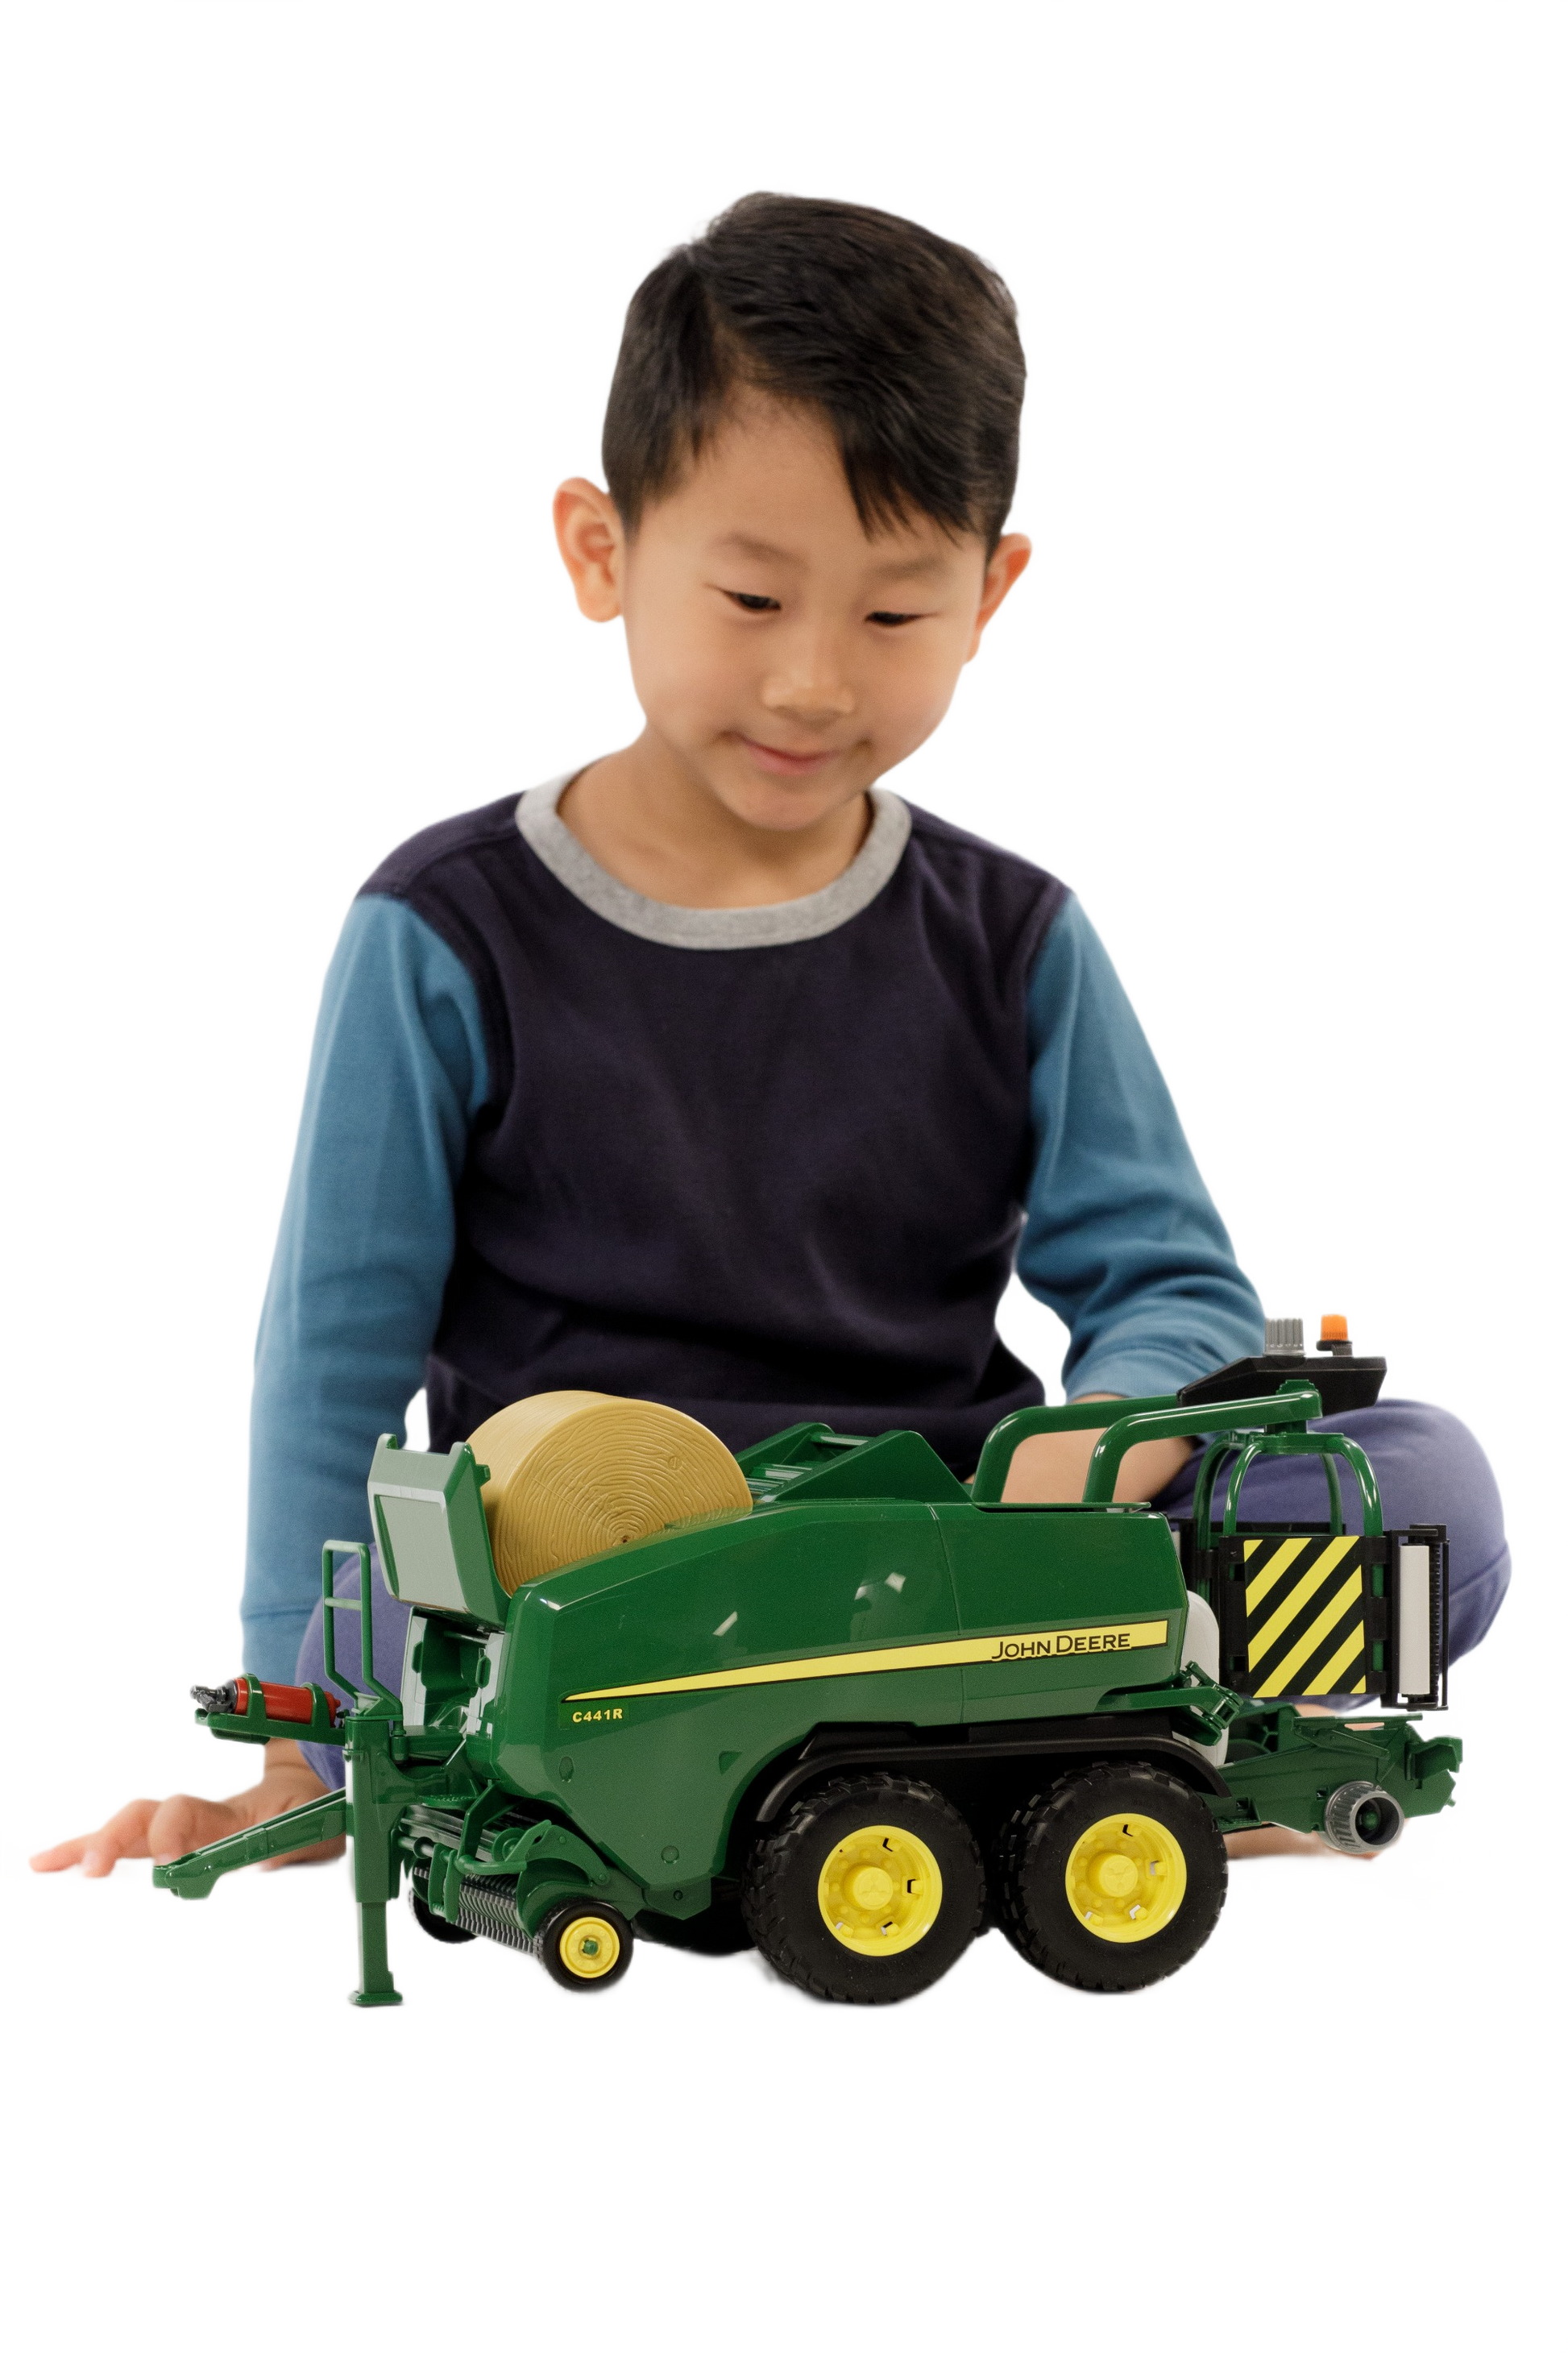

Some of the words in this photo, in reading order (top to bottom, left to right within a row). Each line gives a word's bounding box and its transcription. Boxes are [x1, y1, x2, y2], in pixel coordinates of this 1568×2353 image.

[991, 1640, 1051, 1659] JOHN
[1056, 1633, 1130, 1653] DEERE
[572, 1708, 623, 1723] C441R
